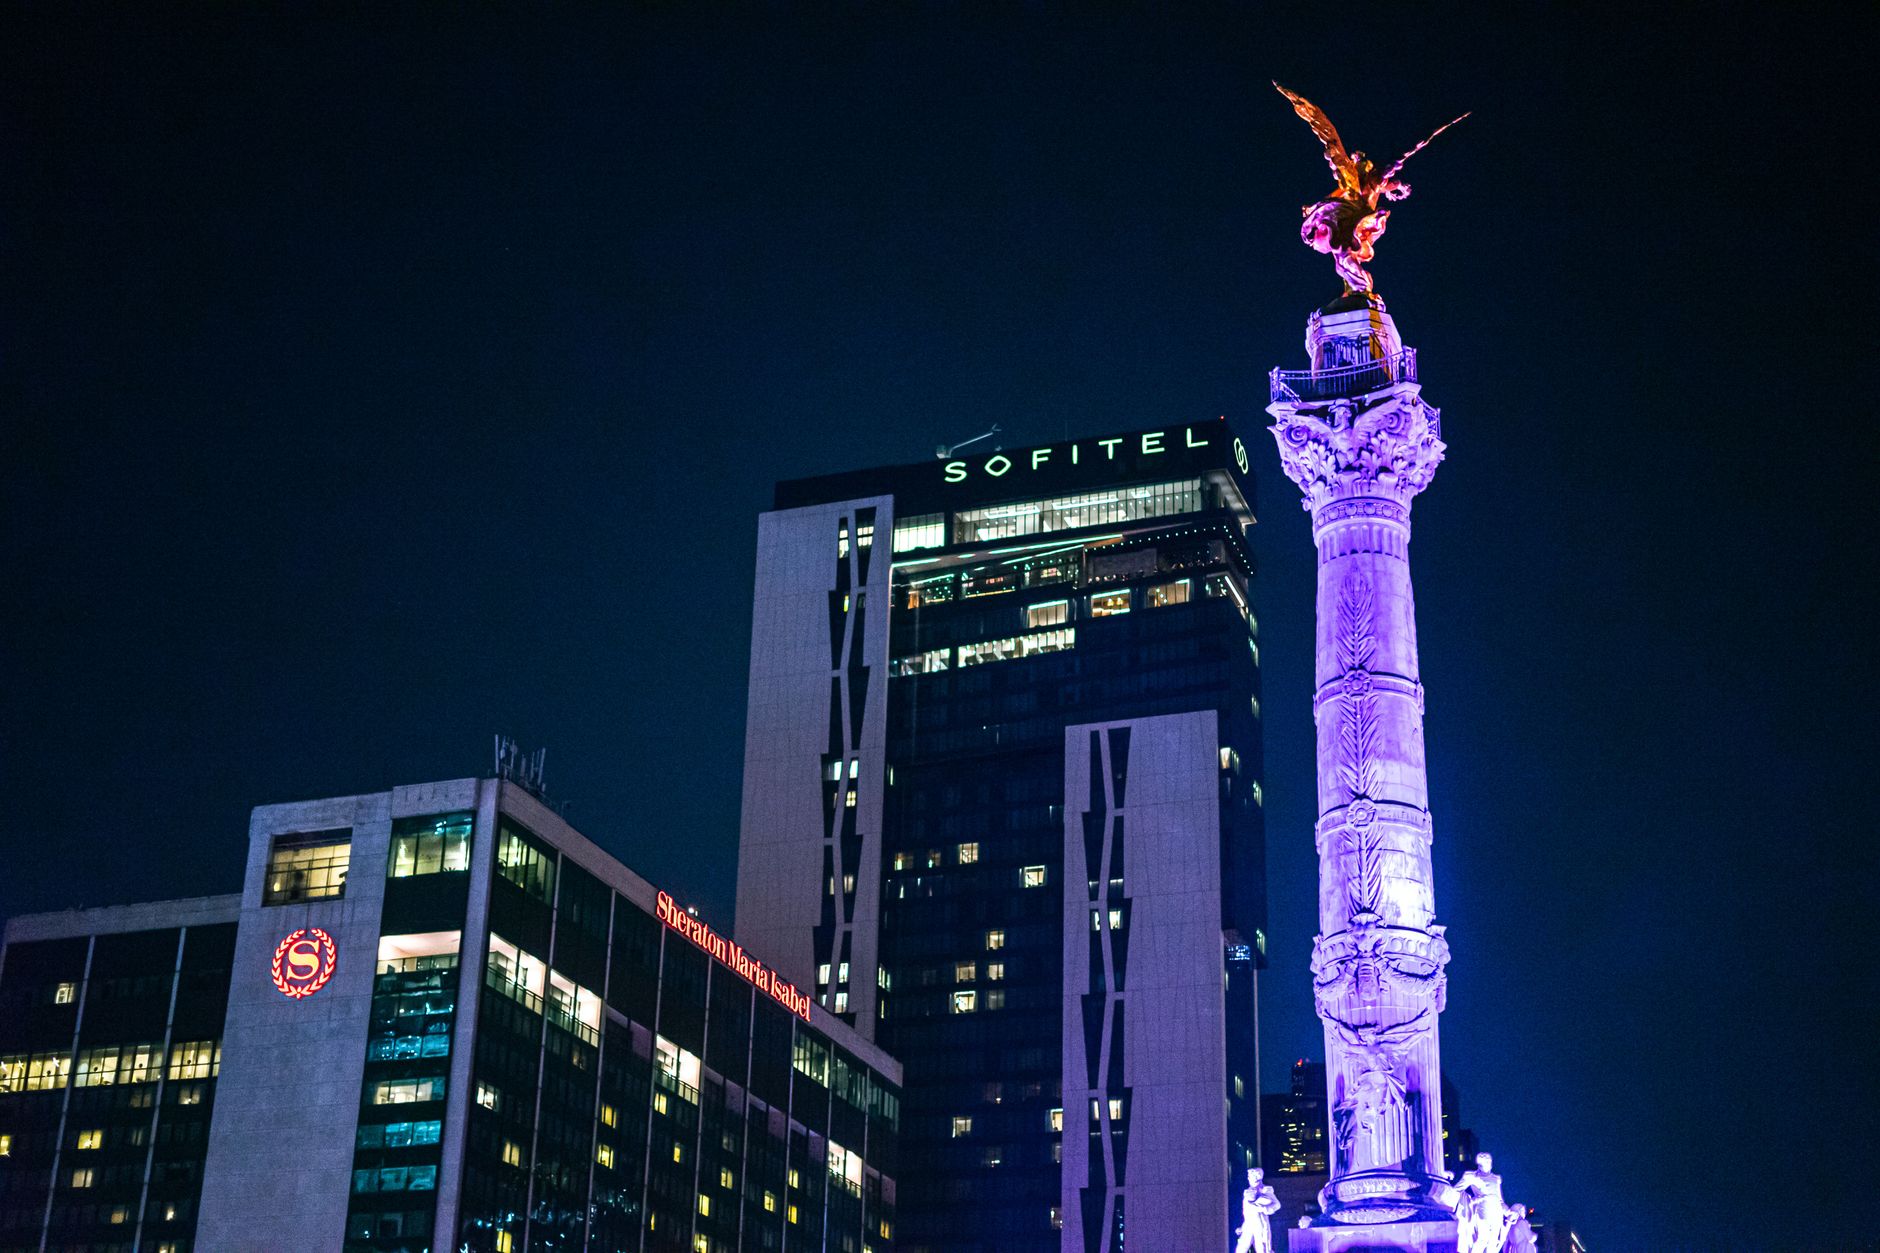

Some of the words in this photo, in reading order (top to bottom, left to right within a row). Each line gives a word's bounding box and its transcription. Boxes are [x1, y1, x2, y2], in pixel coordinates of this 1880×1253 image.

[944, 427, 1209, 482] SOFITEL
[286, 940, 320, 980] S
[656, 891, 727, 962] Sheraton
[728, 940, 769, 991] Maria
[770, 971, 811, 1022] Isabel
